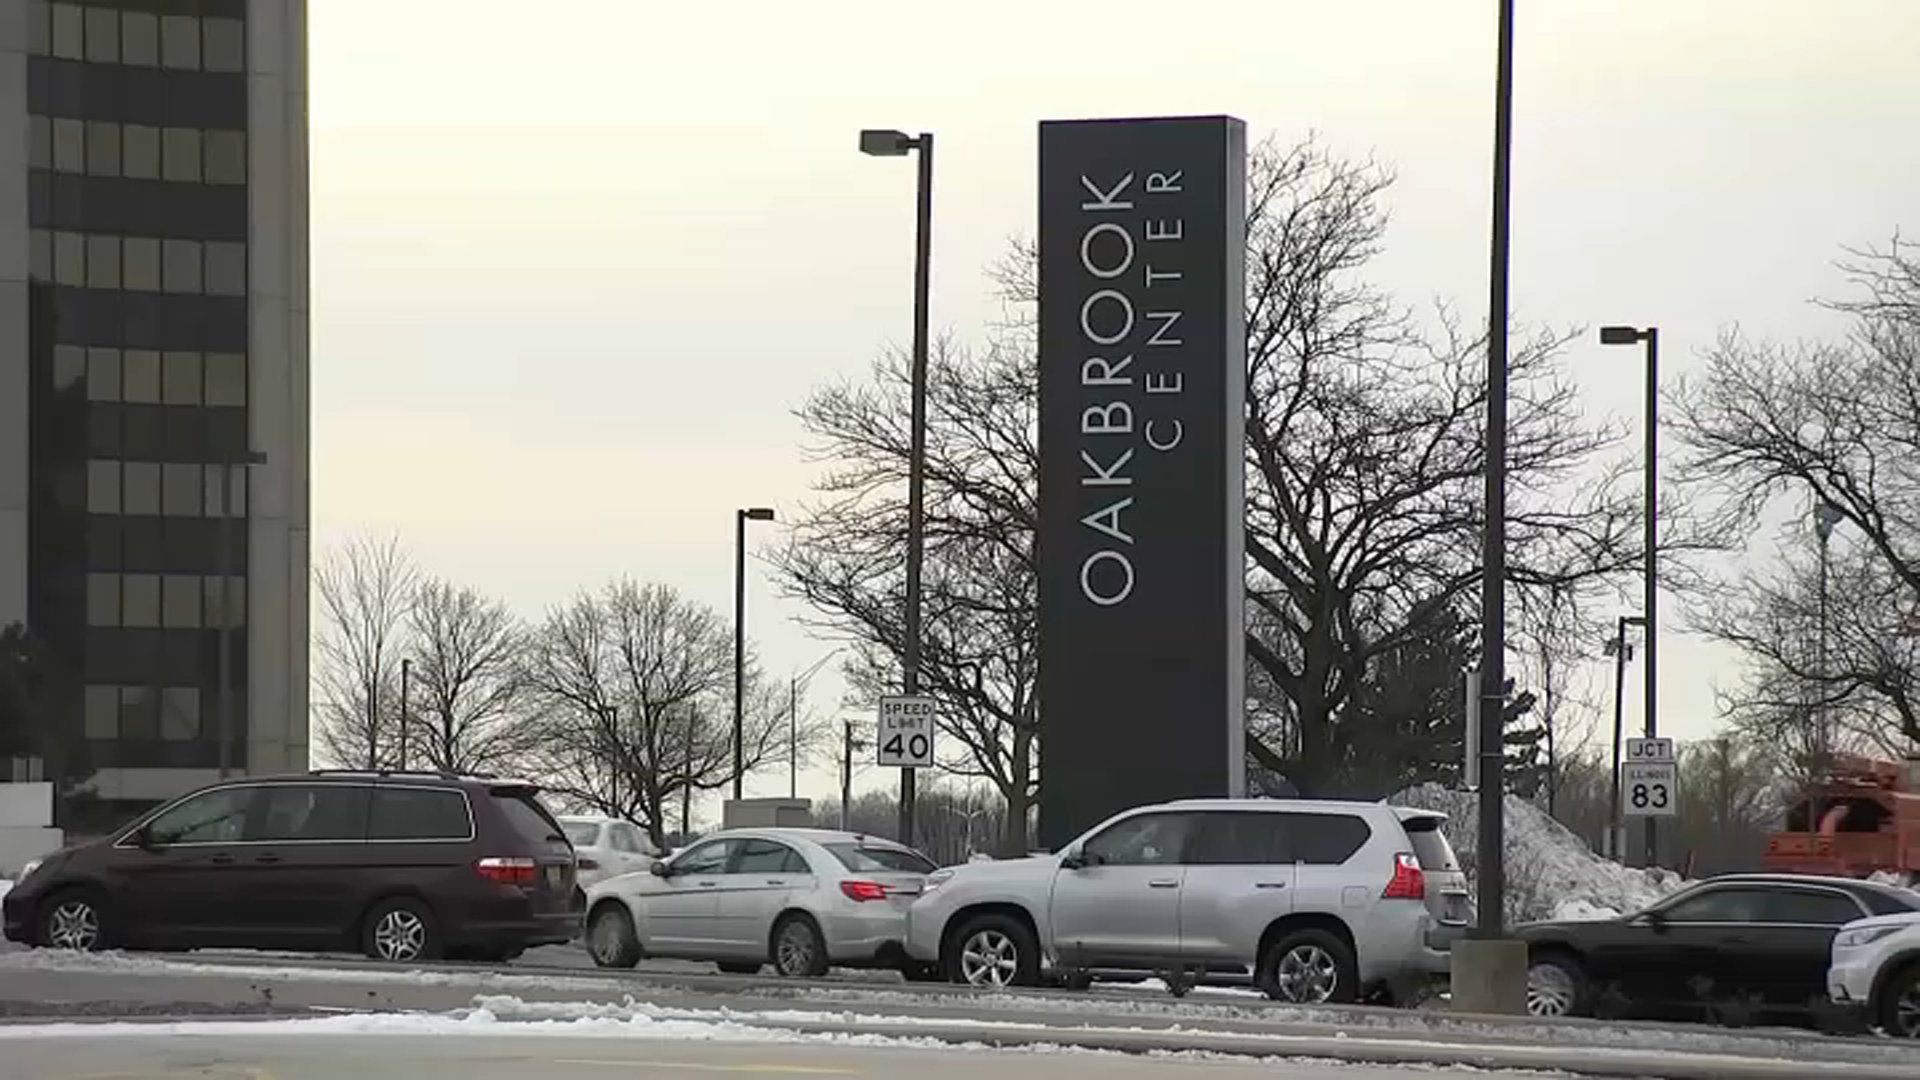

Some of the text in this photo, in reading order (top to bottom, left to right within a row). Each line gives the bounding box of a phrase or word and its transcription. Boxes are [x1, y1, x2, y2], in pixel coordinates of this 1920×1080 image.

[1146, 169, 1183, 451] CENTER
[1081, 171, 1134, 606] OAKBROOK
[885, 703, 932, 715] SPEED
[883, 733, 929, 759] 40
[1631, 742, 1666, 757] JCT
[1632, 783, 1668, 809] 83
